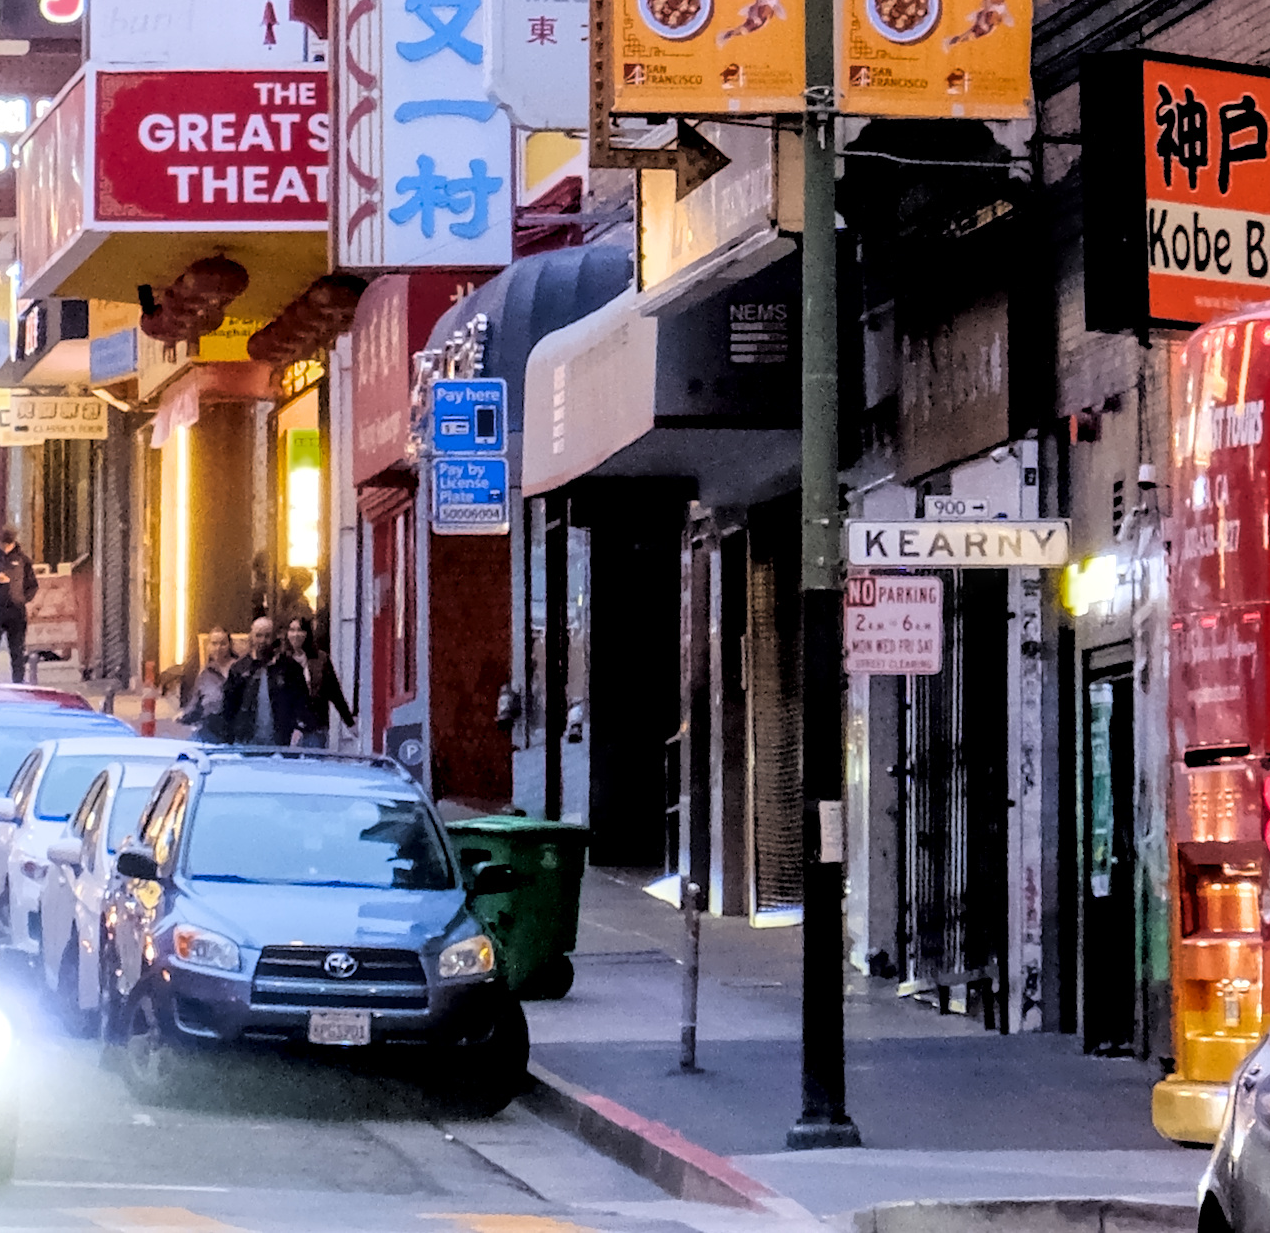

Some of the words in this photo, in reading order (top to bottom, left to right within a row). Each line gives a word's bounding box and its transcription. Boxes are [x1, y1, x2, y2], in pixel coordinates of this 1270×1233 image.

[254, 82, 315, 106] THE
[138, 114, 302, 153] GREAT
[307, 114, 329, 153] S
[1148, 207, 1232, 276] Kobe
[729, 303, 788, 321] NEMS
[437, 387, 463, 404] Pay
[465, 387, 501, 402] here
[439, 463, 464, 477] Pay
[468, 462, 486, 477] by
[439, 477, 490, 489] License
[439, 490, 475, 503] Plate
[933, 500, 966, 515] 900
[864, 528, 1058, 558] KEARNY
[848, 579, 874, 604] NO
[878, 586, 937, 604] PARKING
